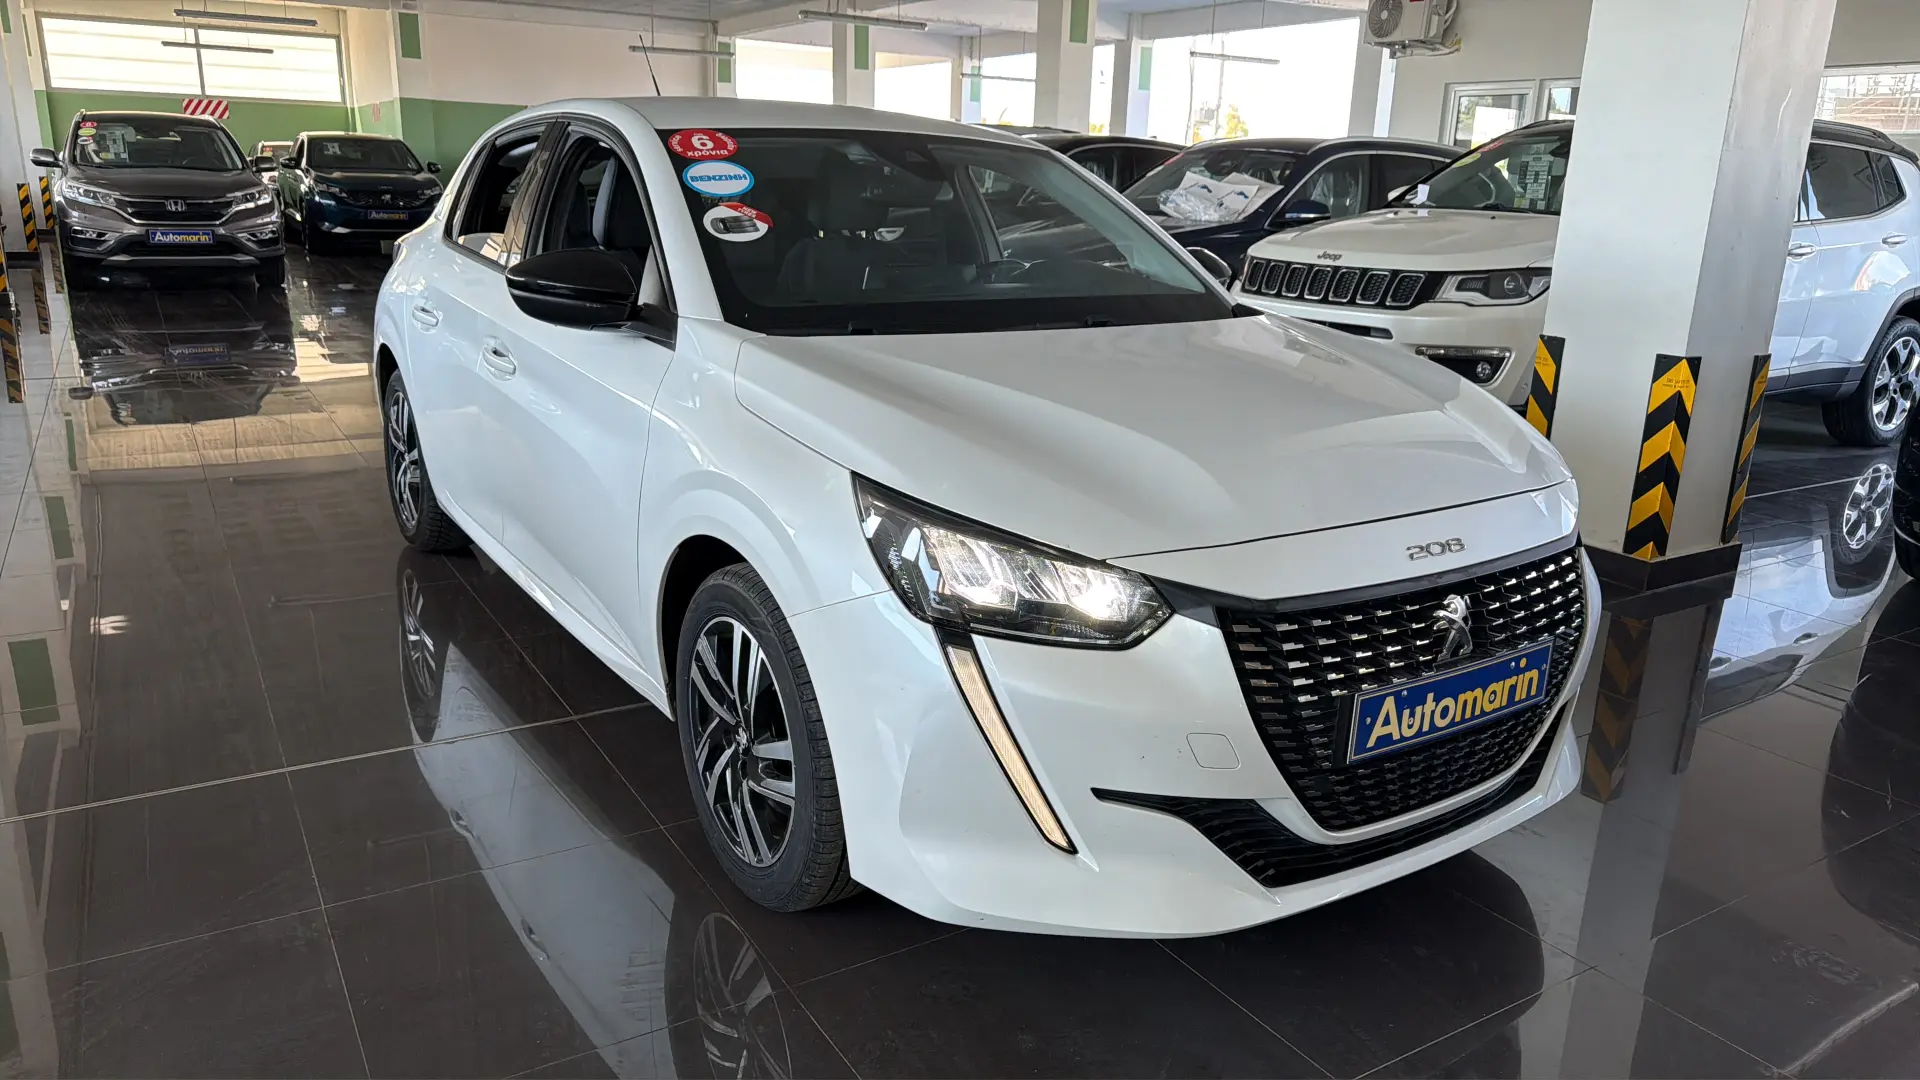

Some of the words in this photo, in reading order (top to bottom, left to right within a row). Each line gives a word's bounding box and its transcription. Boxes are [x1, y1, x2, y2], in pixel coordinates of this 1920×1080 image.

[691, 135, 714, 149] 6
[686, 149, 728, 157] χρόνια
[155, 231, 209, 242] Automarin
[1317, 251, 1342, 262] Jeep
[1406, 537, 1466, 561] 208
[1366, 657, 1539, 748] Automarin
